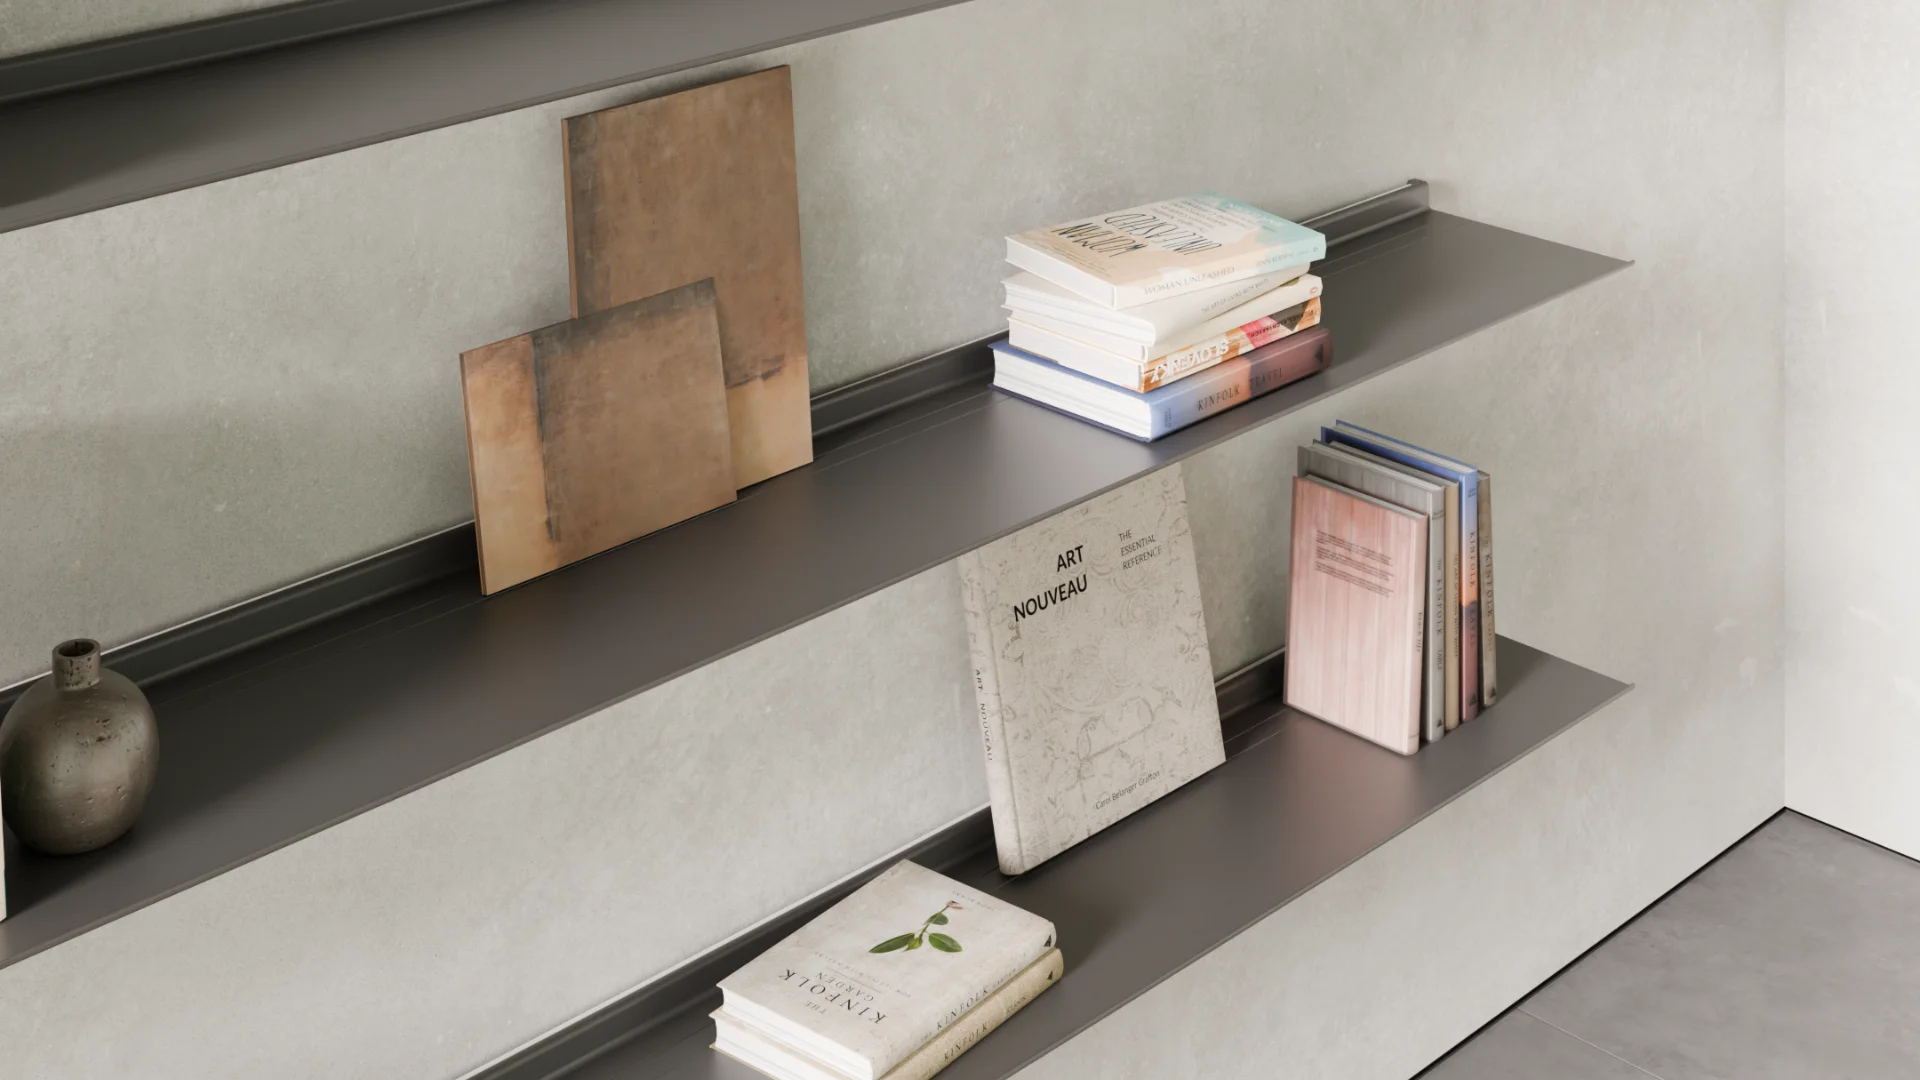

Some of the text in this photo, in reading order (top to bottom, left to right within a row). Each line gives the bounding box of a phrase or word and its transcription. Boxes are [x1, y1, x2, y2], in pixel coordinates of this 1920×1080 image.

[1051, 222, 1148, 258] WOMAN
[1104, 213, 1222, 256] UNLEASHED
[1144, 266, 1235, 296] WOMAN UNLEASHED
[1198, 384, 1241, 412] KINFOLK
[1118, 529, 1132, 543] THE
[1120, 534, 1156, 557] ESSENTIAL
[1056, 545, 1084, 572] ART
[1122, 545, 1162, 571] REFERENCE
[1013, 574, 1088, 622] NOUVEAU
[980, 703, 993, 761] NOUVEAU
[1095, 796, 1111, 810] Carol
[1111, 782, 1137, 803] Belanger
[779, 968, 888, 1025] KINFOLK
[816, 972, 874, 1002] GARDEN
[804, 1001, 828, 1014] THE
[936, 984, 988, 1030] KINFOLK
[944, 1022, 987, 1061] KINFOLK
